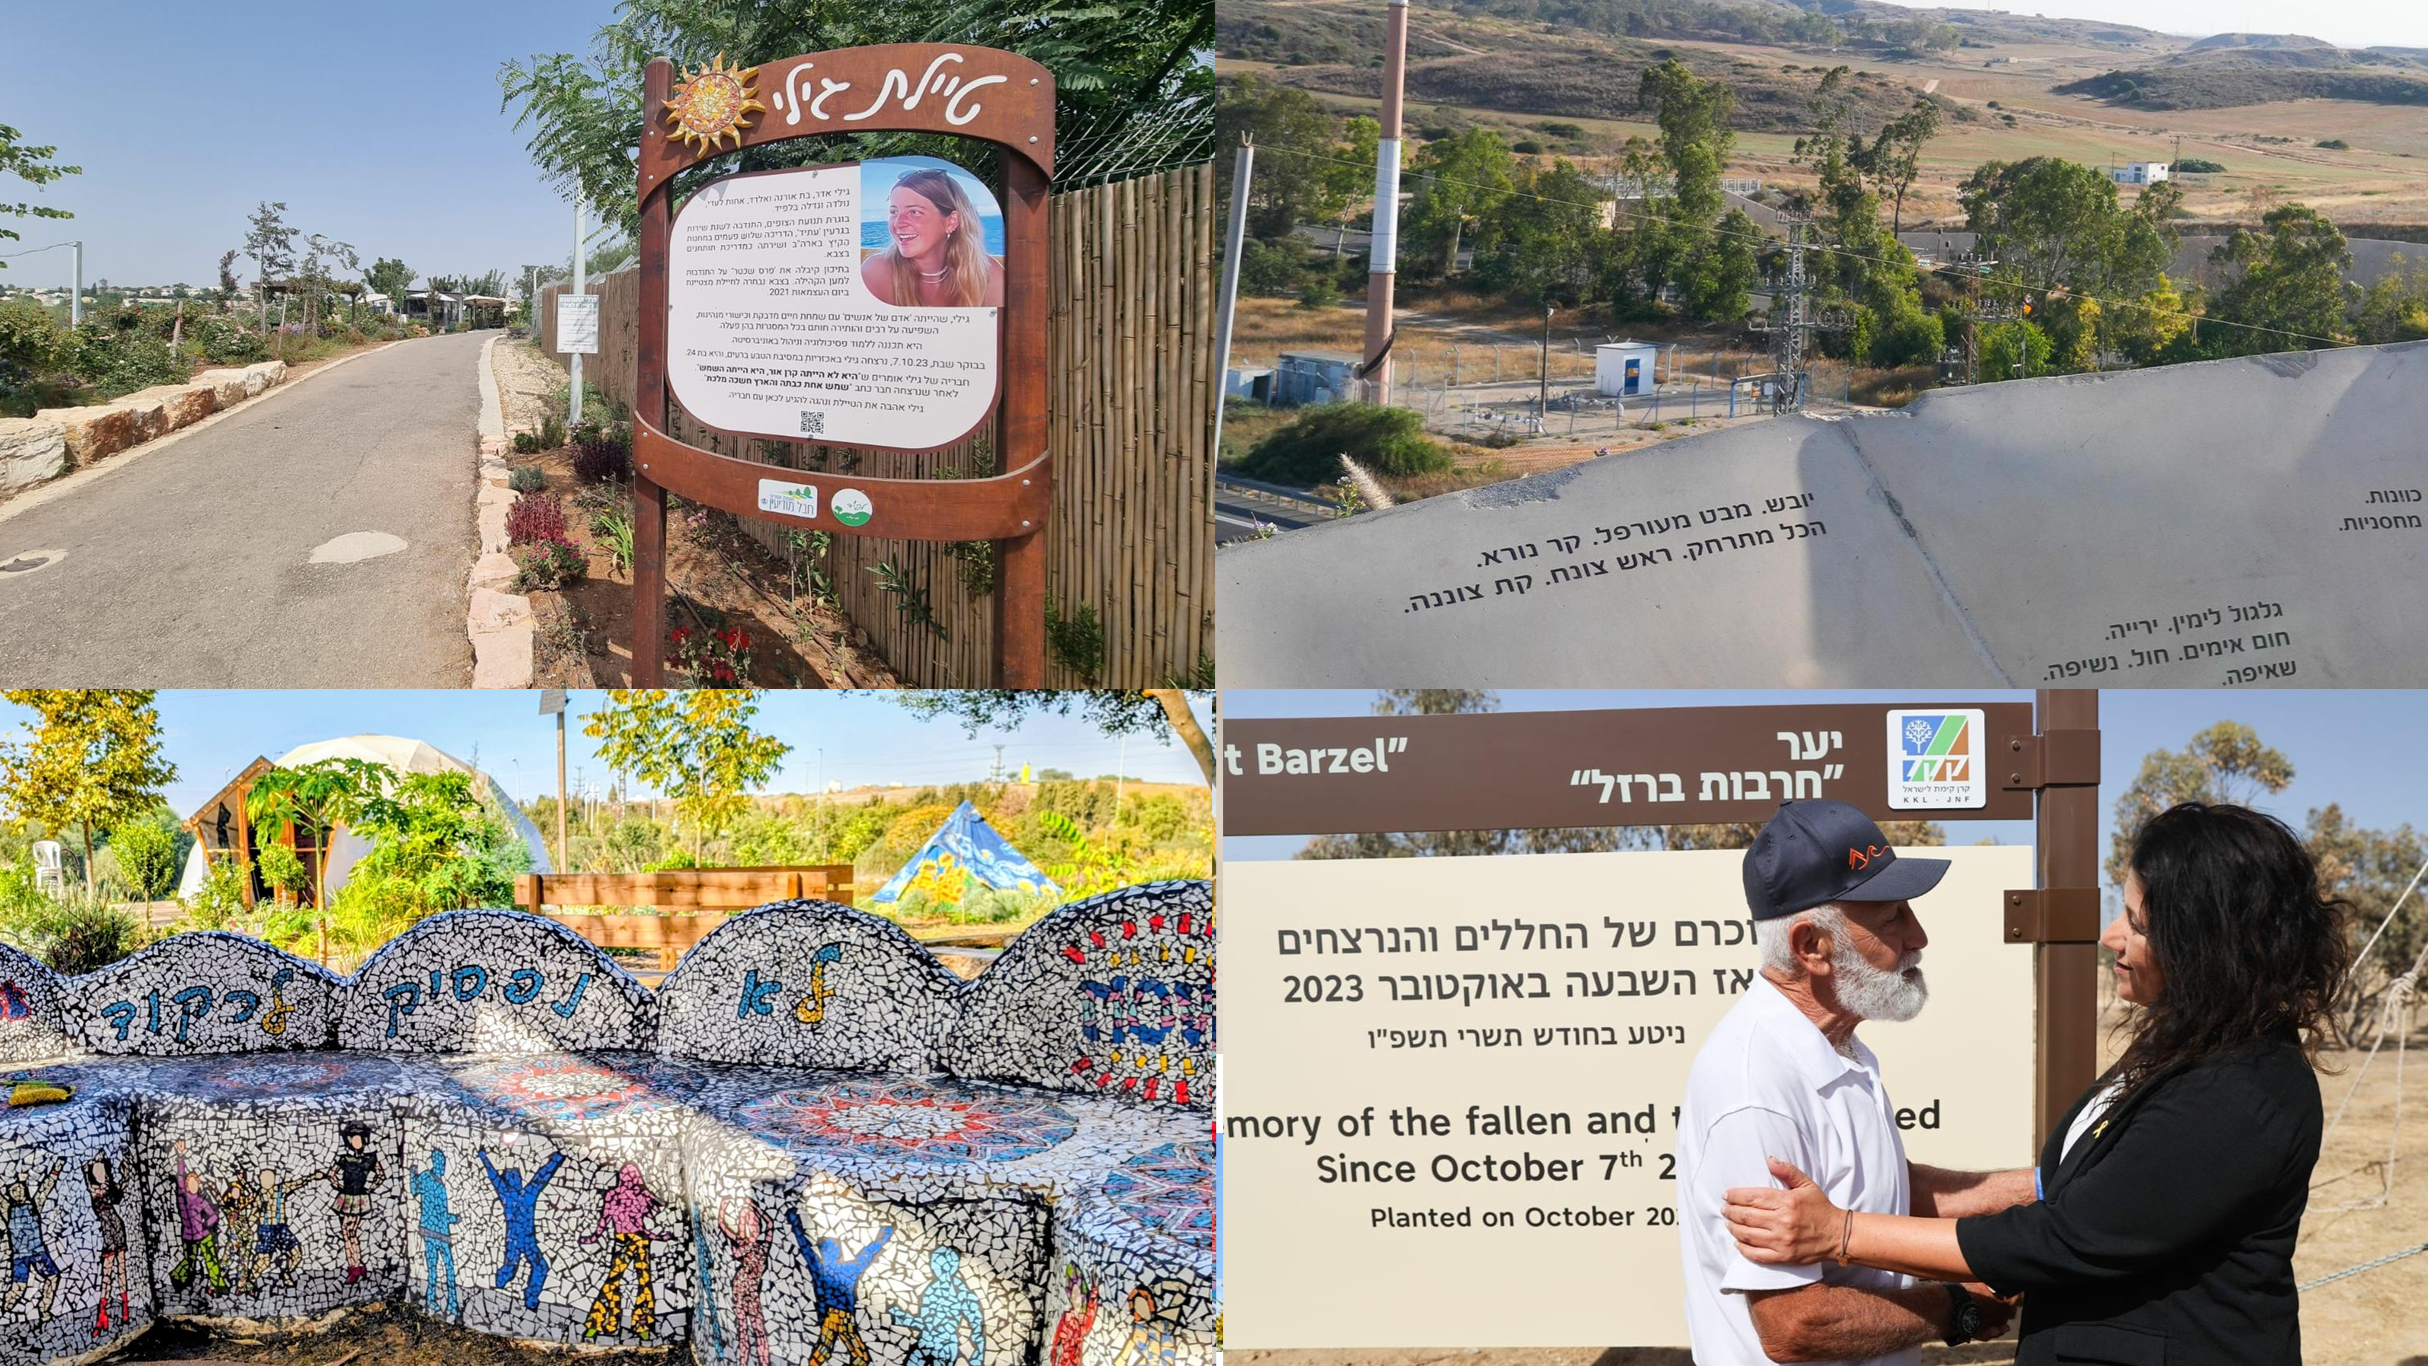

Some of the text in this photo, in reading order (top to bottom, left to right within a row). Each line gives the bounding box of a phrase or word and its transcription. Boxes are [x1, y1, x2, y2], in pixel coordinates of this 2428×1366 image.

[773, 52, 1008, 126] טיילת גילי
[798, 191, 810, 199] בת
[834, 188, 850, 196] גילי
[725, 197, 744, 205] אחות
[773, 193, 796, 201] אורנה
[800, 199, 849, 210] נולדה וגדלה
[797, 217, 822, 225] תנועת
[825, 215, 850, 224] בוגרת
[710, 222, 730, 230] לשנת
[732, 221, 762, 229] התנדבה
[714, 226, 849, 241] בגרעין הדריכה שלוש פעמים
[757, 238, 849, 249] הקיץ ושירתה
[717, 267, 727, 275] על
[795, 265, 819, 275] קיבלה
[823, 265, 849, 275] בתיכון
[828, 275, 849, 286] למען
[752, 312, 779, 320] מדבקת
[799, 312, 826, 320] שמחת
[874, 312, 888, 321] של
[913, 314, 948, 323] שהייתה
[741, 322, 754, 330] בהן
[790, 322, 805, 331] בכל
[865, 325, 885, 333] רבים
[887, 324, 899, 333] על
[901, 326, 938, 334] השפיעה
[780, 336, 802, 345] וניהול
[849, 339, 875, 348] ללמוד
[877, 341, 903, 349] תכננה
[772, 353, 803, 361] במסיבת
[843, 355, 858, 364] גילי
[860, 356, 887, 365] נרצחה
[725, 365, 748, 373] הייתה
[956, 361, 985, 370] בבוקר
[783, 369, 798, 378] קרן
[799, 369, 825, 378] הייתה
[826, 370, 839, 379] לא
[871, 373, 903, 382] אומרים
[905, 374, 921, 383] גילי
[923, 375, 938, 385] של
[940, 377, 969, 386] חבריה
[728, 376, 958, 398] לאחר שנרצחה חבר כתב אחת כבתה והארץ חשכה
[765, 393, 783, 402] לכאן
[785, 395, 807, 403] להגיע
[809, 397, 830, 405] ונהגה
[832, 398, 862, 408] הטיילת
[863, 401, 877, 409] את
[879, 402, 905, 411] אהבה
[907, 403, 923, 413] גילי
[2365, 489, 2421, 503] כוונות.
[2339, 515, 2421, 530] מחסניות.
[1477, 488, 1817, 567] יובש. מבט מעורפל. קר נורא.
[1404, 518, 1827, 613] הכל מתרחק. ראש צונח. קת צוננה.
[2104, 601, 2282, 640] גלגול לימין. ירייה.
[2043, 631, 2290, 680] חום אימים. חול. נשיפה.
[2222, 660, 2296, 685] שאיפה.
[1777, 731, 1843, 760] יער
[1902, 785, 1971, 794] קרן קימת לישראל
[1455, 918, 1587, 951] החללים
[1603, 916, 1655, 948] של
[1277, 926, 1438, 955] והנרצחים
[1566, 969, 1696, 997] השבעה
[1282, 974, 1363, 1002] 2023
[1378, 972, 1550, 1006] באוקטובר
[101, 969, 294, 1042] לרקוד
[382, 965, 590, 1038] נפסיק
[1457, 1028, 1522, 1047] תשרי
[1533, 1026, 1617, 1046] בחודש
[1628, 1025, 1684, 1044] ניטע
[1223, 1115, 1321, 1145] mory
[1337, 1106, 1374, 1137] of
[1389, 1106, 1450, 1136] the
[1465, 1104, 1571, 1135] fallen
[1587, 1103, 1655, 1134] and
[1316, 1152, 1415, 1183] Since
[1431, 1151, 1583, 1182] October
[1370, 1205, 1679, 1227] Planted on October 20
